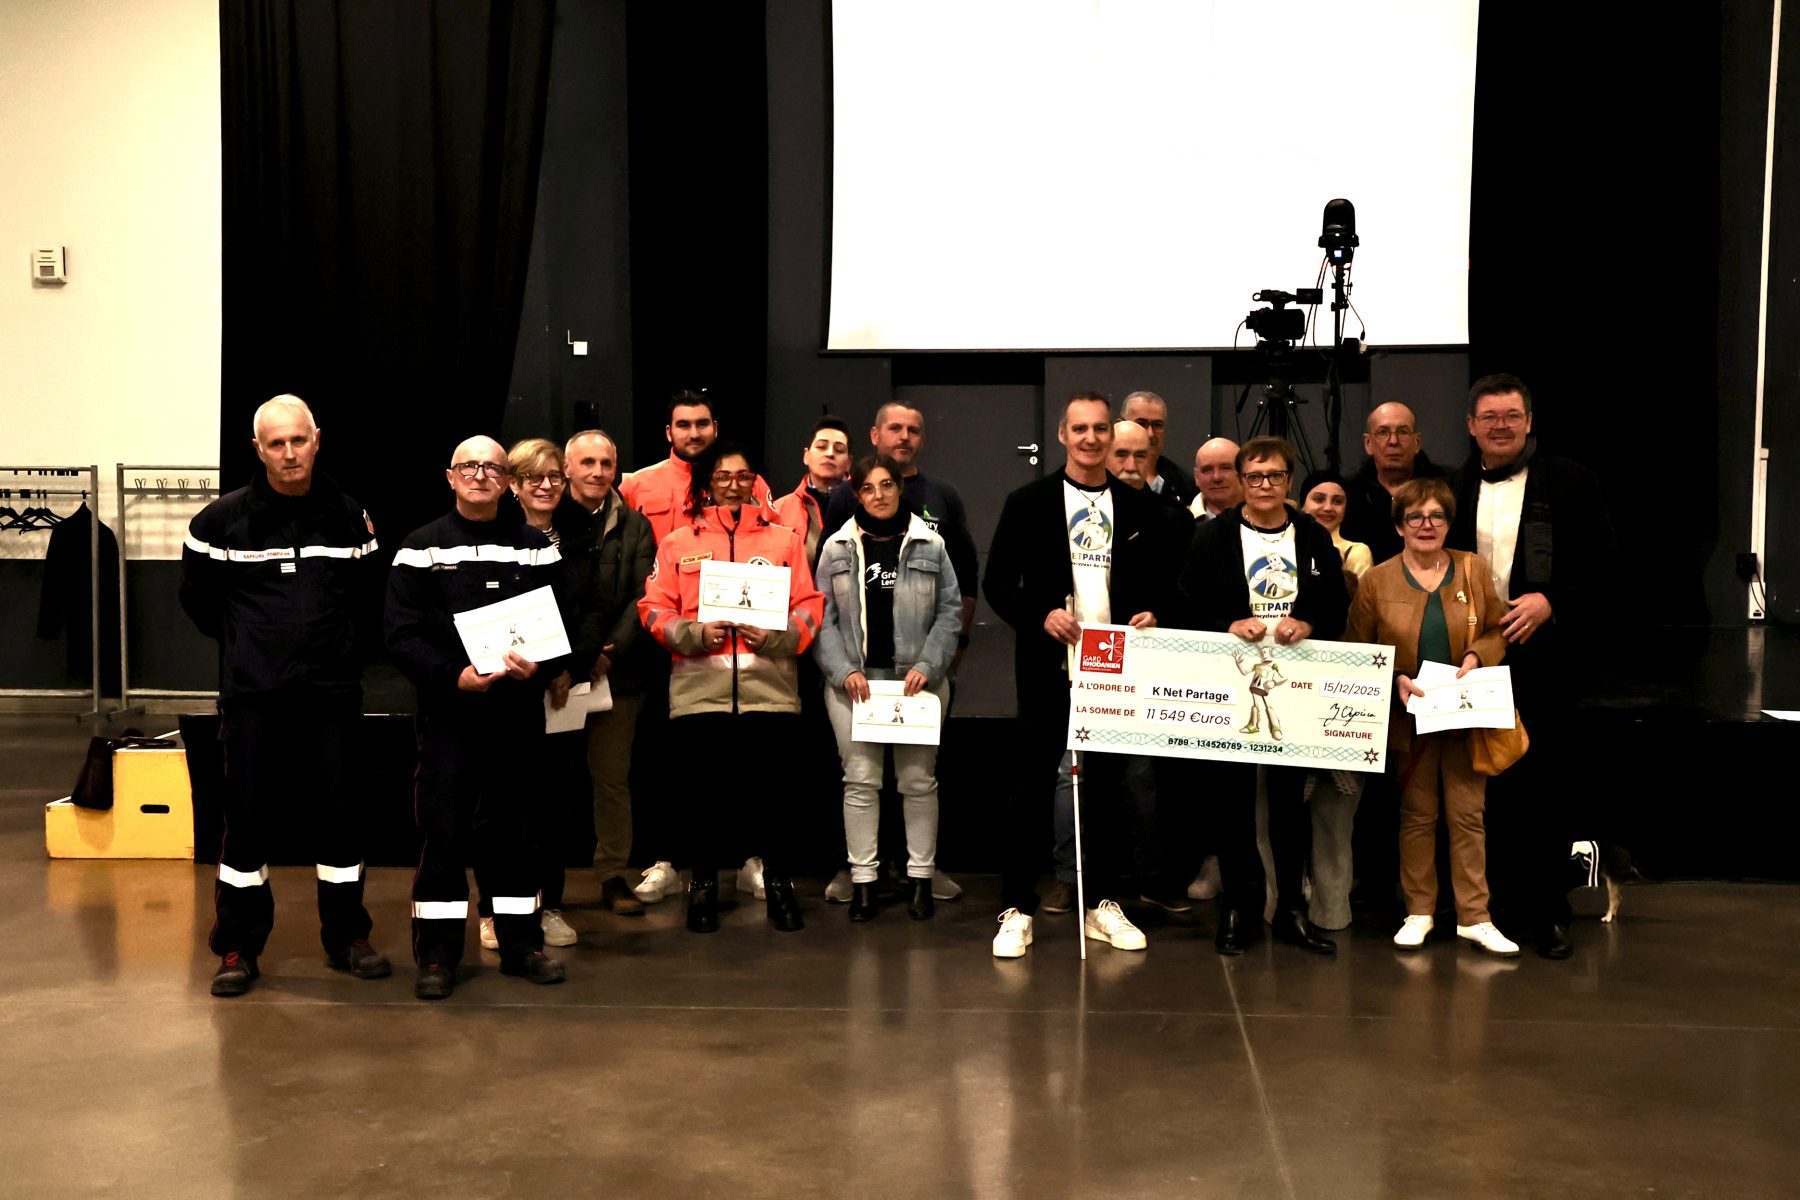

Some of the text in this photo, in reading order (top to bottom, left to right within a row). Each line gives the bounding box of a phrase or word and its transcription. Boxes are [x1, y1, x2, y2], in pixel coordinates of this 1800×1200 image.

[1072, 552, 1110, 562] ETPARTA
[1082, 654, 1102, 662] GARD
[1082, 660, 1121, 669] RHODANIEN
[1078, 681, 1230, 702] À L'ORDRE DE K Net Partage
[1290, 681, 1380, 696] DATE 15/12/2025
[1088, 706, 1122, 715] SOMME
[1124, 709, 1136, 717] DE
[1146, 708, 1156, 719] 11
[1159, 709, 1186, 722] 549
[1190, 711, 1231, 726] €uros
[1324, 729, 1373, 740] SIGNATURE
[1249, 743, 1283, 753] 1231234
